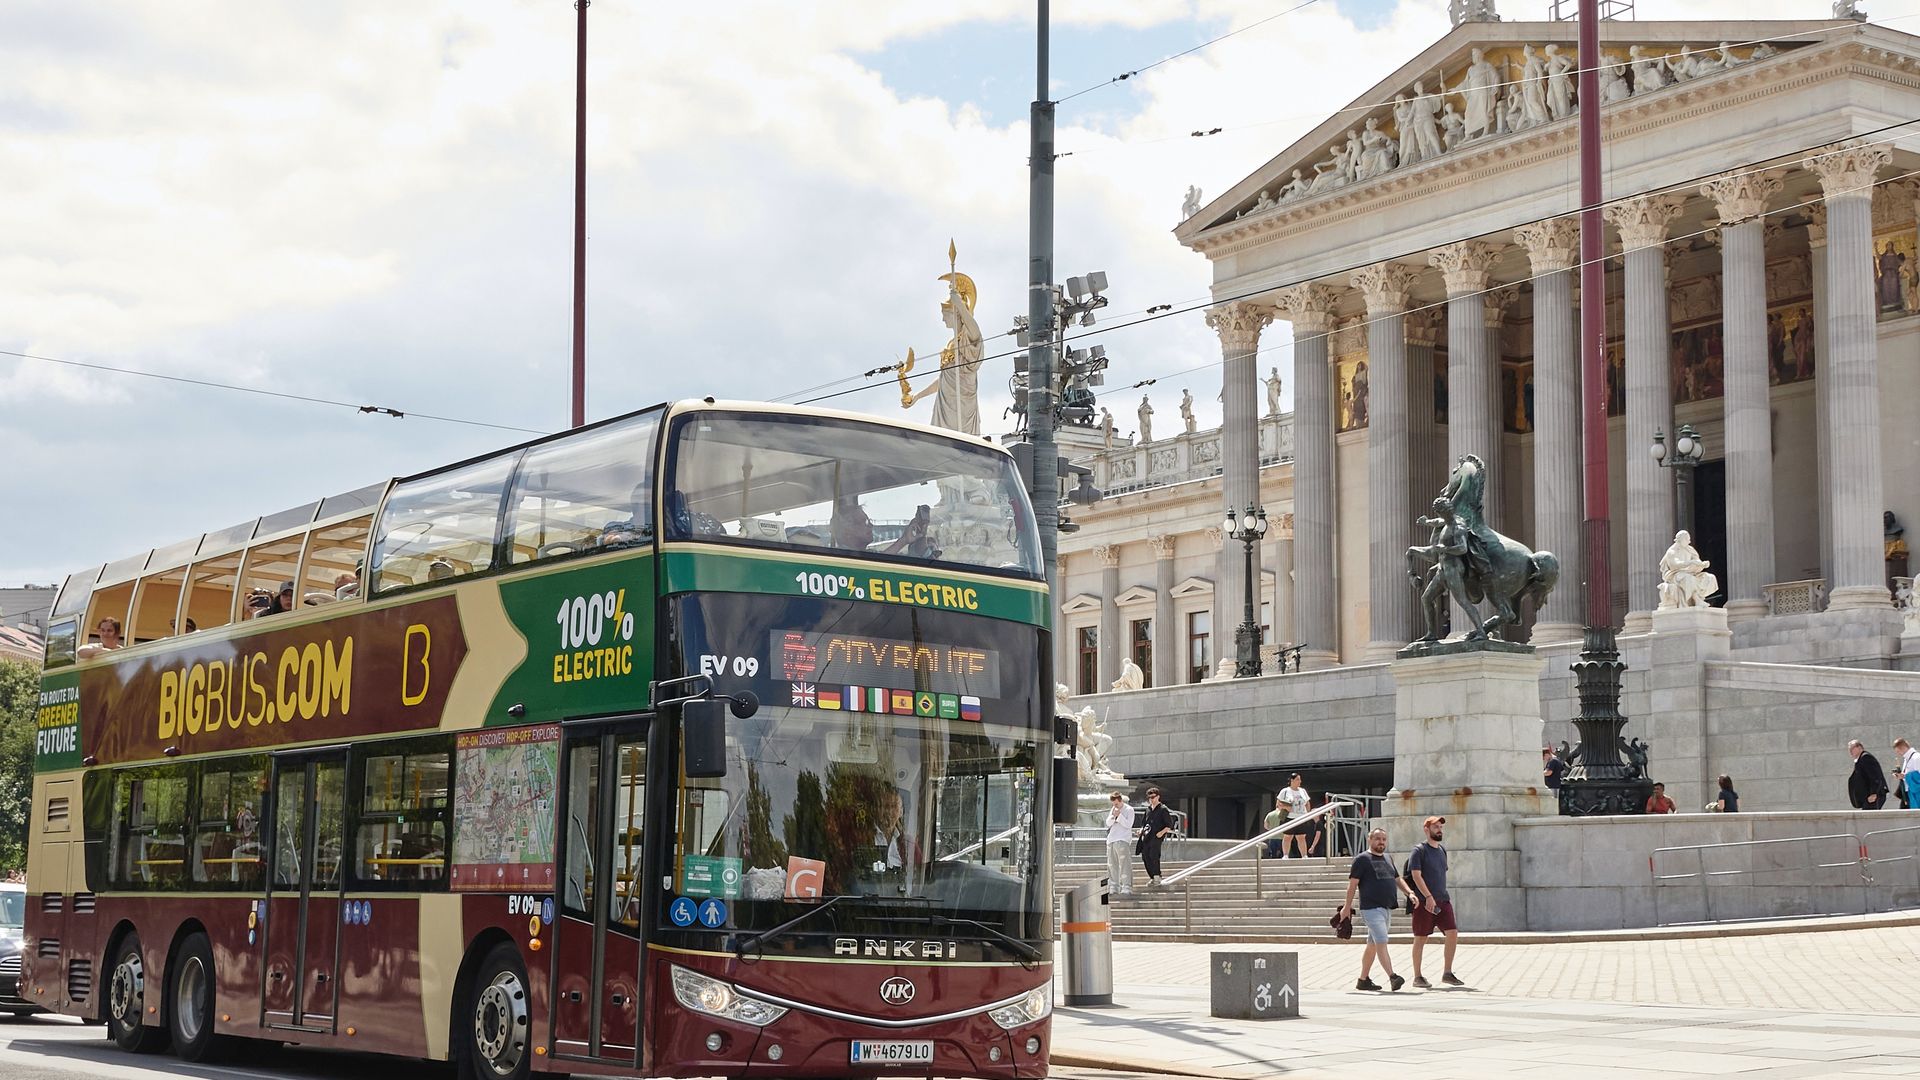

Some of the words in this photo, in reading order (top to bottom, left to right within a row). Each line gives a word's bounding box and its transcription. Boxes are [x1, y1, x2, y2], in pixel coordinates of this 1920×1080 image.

[796, 571, 865, 599] 100%
[869, 578, 979, 610] ELECTRIC
[556, 588, 634, 650] 100%
[402, 624, 431, 706] B
[553, 645, 633, 683] ELECTRIC
[700, 655, 728, 676] EV
[732, 656, 759, 677] 09
[40, 692, 48, 706] EN
[48, 689, 67, 704] ROUTE
[67, 687, 75, 701] TO
[74, 686, 79, 700] A
[158, 636, 354, 740] BIGBUS.COM
[39, 703, 78, 728] GREENER
[37, 726, 77, 755] FUTURE
[457, 735, 479, 747] HOP-ON
[479, 732, 505, 746] DISCOVER
[506, 730, 531, 743] HOP-OFF
[532, 727, 559, 740] EXPLORE
[790, 869, 817, 903] G
[508, 895, 521, 914] EV
[522, 895, 534, 915] 09
[543, 903, 552, 919] IN
[834, 938, 957, 958] ANKAI
[862, 1044, 873, 1059] W
